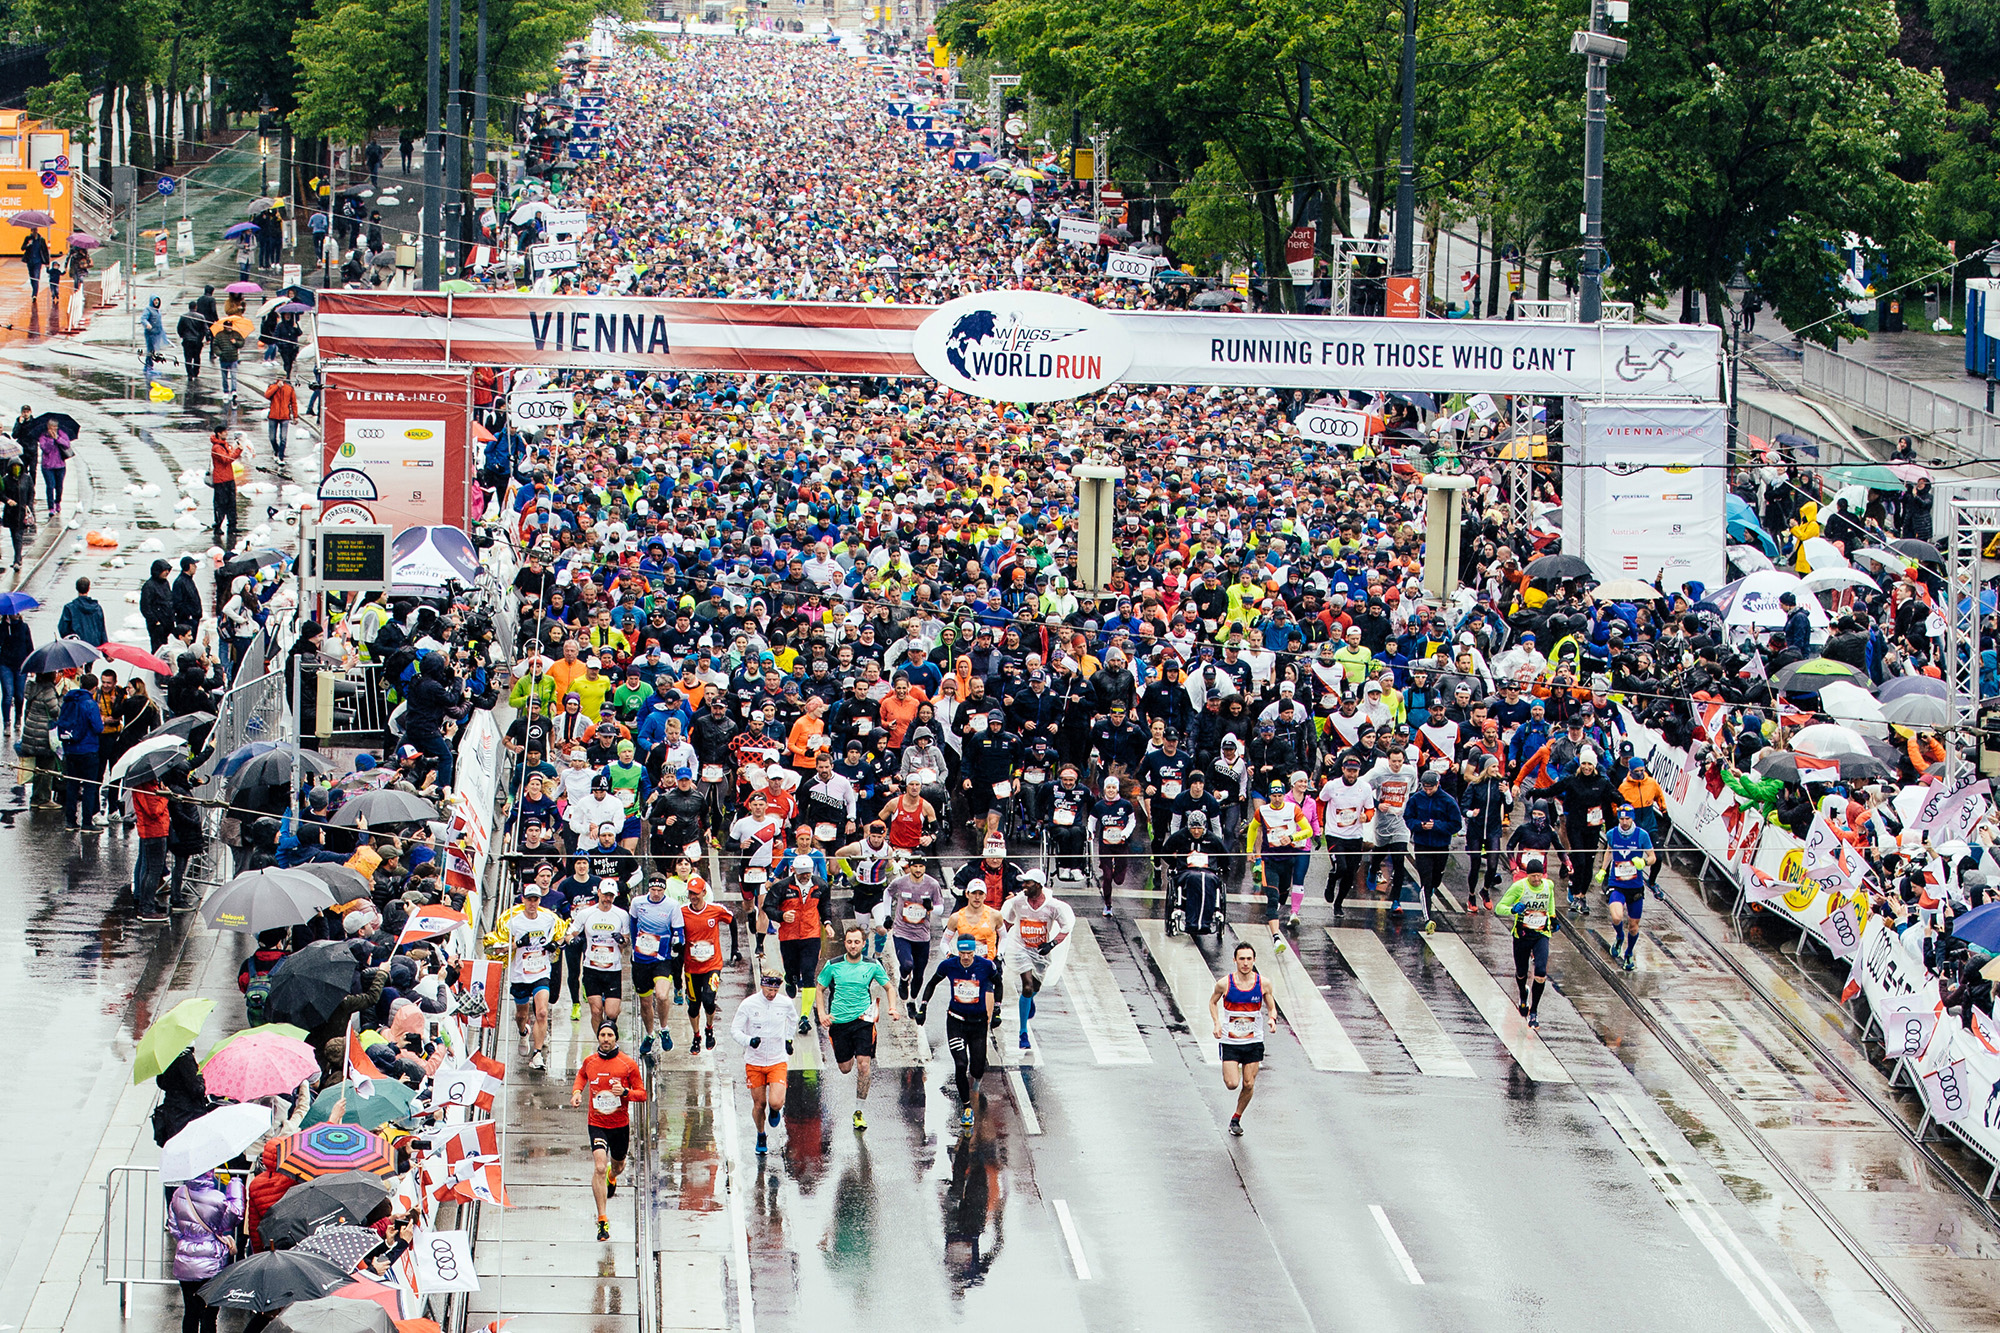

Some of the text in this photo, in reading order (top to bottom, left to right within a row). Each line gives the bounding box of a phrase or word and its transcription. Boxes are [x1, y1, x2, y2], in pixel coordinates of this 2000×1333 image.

[1061, 226, 1098, 236] e-tron
[529, 311, 670, 355] VIENNA
[995, 325, 1051, 341] WINGS
[1002, 340, 1035, 352] LIFE
[1211, 338, 1312, 365] RUNNING
[1322, 342, 1366, 367] FOR
[1373, 343, 1444, 368] THOSE
[1452, 345, 1503, 370] WHO
[972, 351, 1101, 380] WORLD RUN
[345, 391, 447, 403] VIENNA.INFO
[1606, 427, 1704, 437] VIENNA.INFO
[343, 445, 352, 454] H
[332, 473, 365, 484] AUTOBUS
[325, 506, 370, 522] STRASSENBAHN
[1652, 751, 1692, 806] WORLD RUN
[602, 860, 619, 870] your
